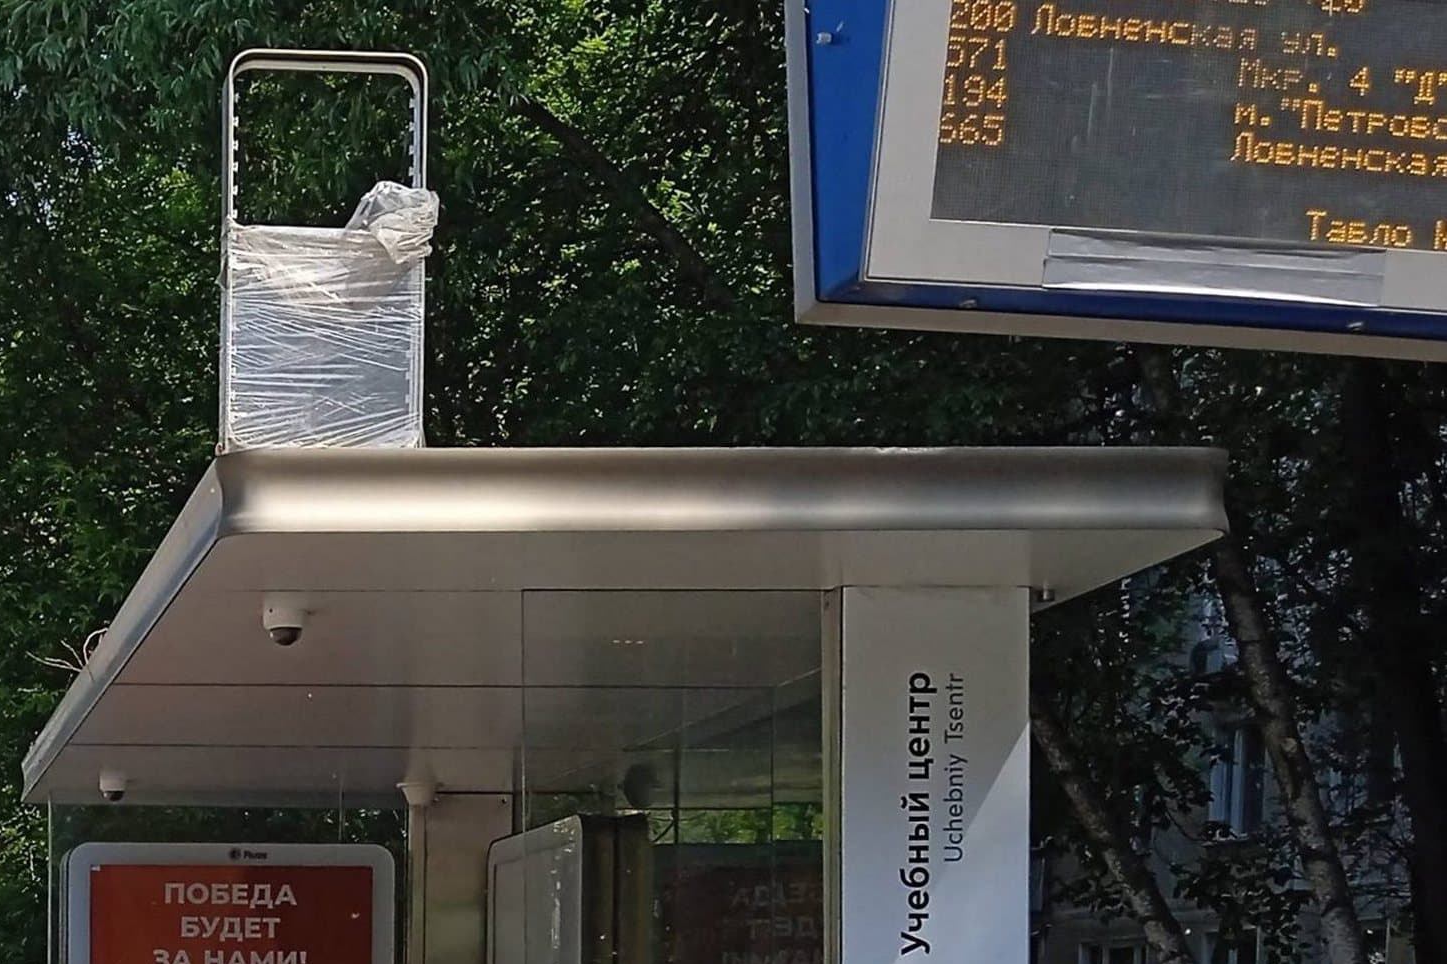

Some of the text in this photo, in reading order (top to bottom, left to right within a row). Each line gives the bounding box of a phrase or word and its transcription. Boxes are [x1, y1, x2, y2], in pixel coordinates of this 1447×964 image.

[950, 0, 1016, 32] 200
[1280, 31, 1338, 57] ул.
[944, 73, 1007, 109] 194
[1234, 102, 1272, 127] м.
[1237, 56, 1319, 94] Мкр.
[1349, 66, 1370, 97] 4
[1305, 208, 1413, 248] Табло
[944, 673, 969, 863] Uchebniy Tsentr
[899, 671, 938, 956] Учебный центр
[164, 882, 298, 910] ПОБЕДА
[180, 915, 281, 942] БУДЕТ
